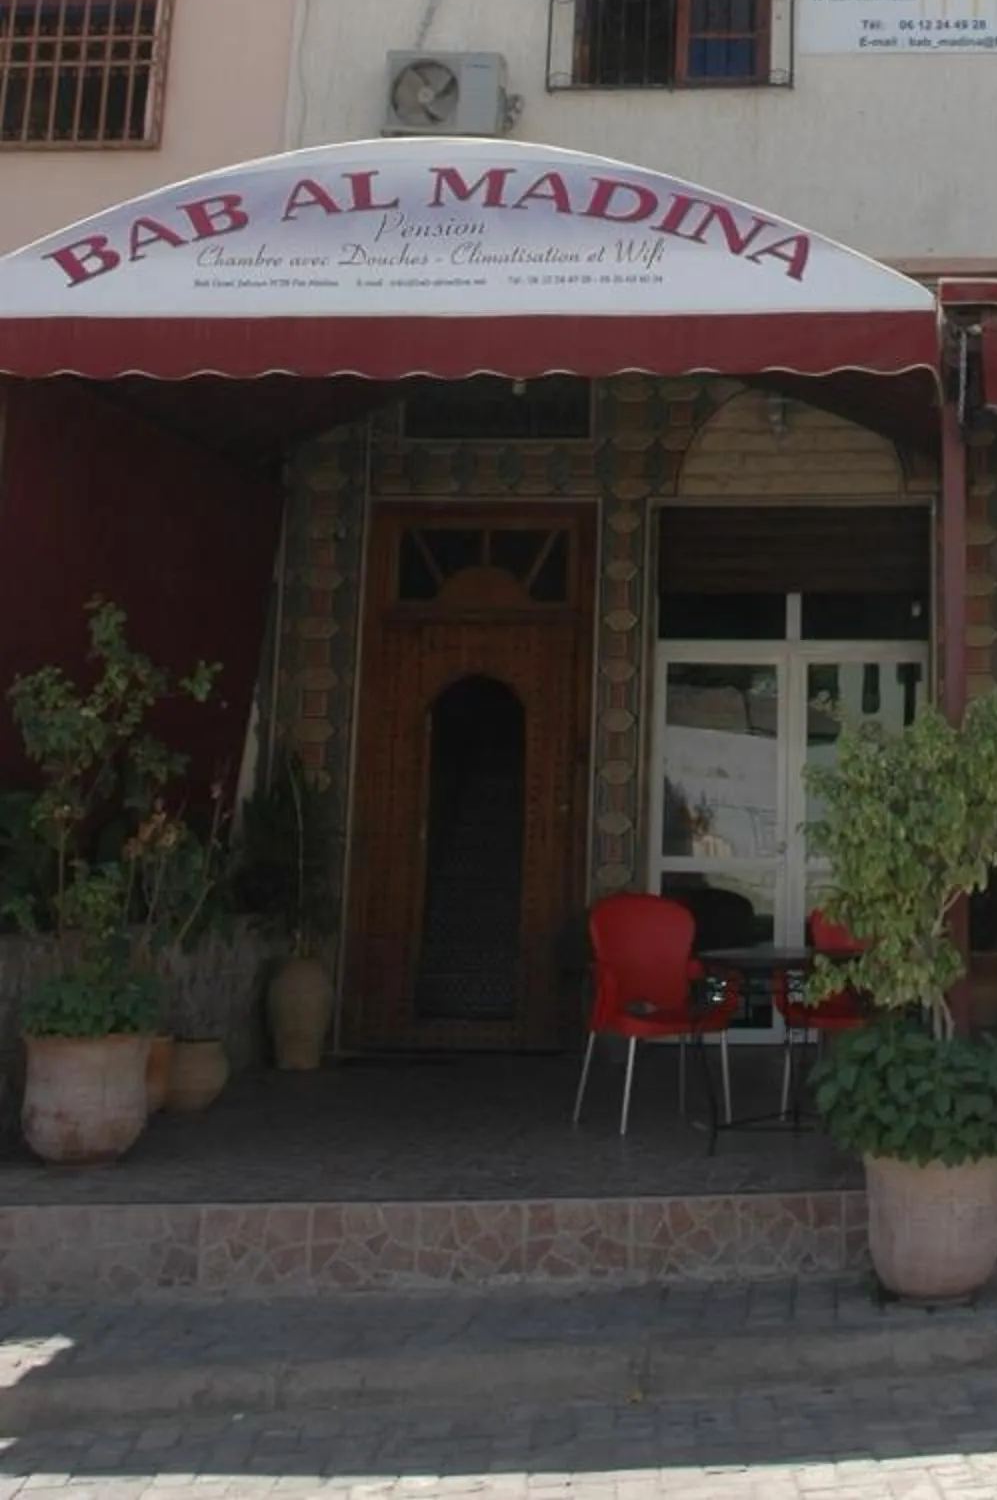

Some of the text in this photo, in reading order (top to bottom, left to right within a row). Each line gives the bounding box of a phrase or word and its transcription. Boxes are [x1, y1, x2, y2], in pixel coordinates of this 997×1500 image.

[935, 19, 950, 30] 24
[42, 166, 814, 286] BAB AL MADINA
[374, 211, 486, 242] Pension
[197, 243, 280, 268] Chambre
[289, 254, 331, 267] avec
[338, 243, 429, 267] Douches
[451, 240, 581, 266] Climatisation
[586, 247, 606, 263] et
[614, 237, 666, 270] Wifi
